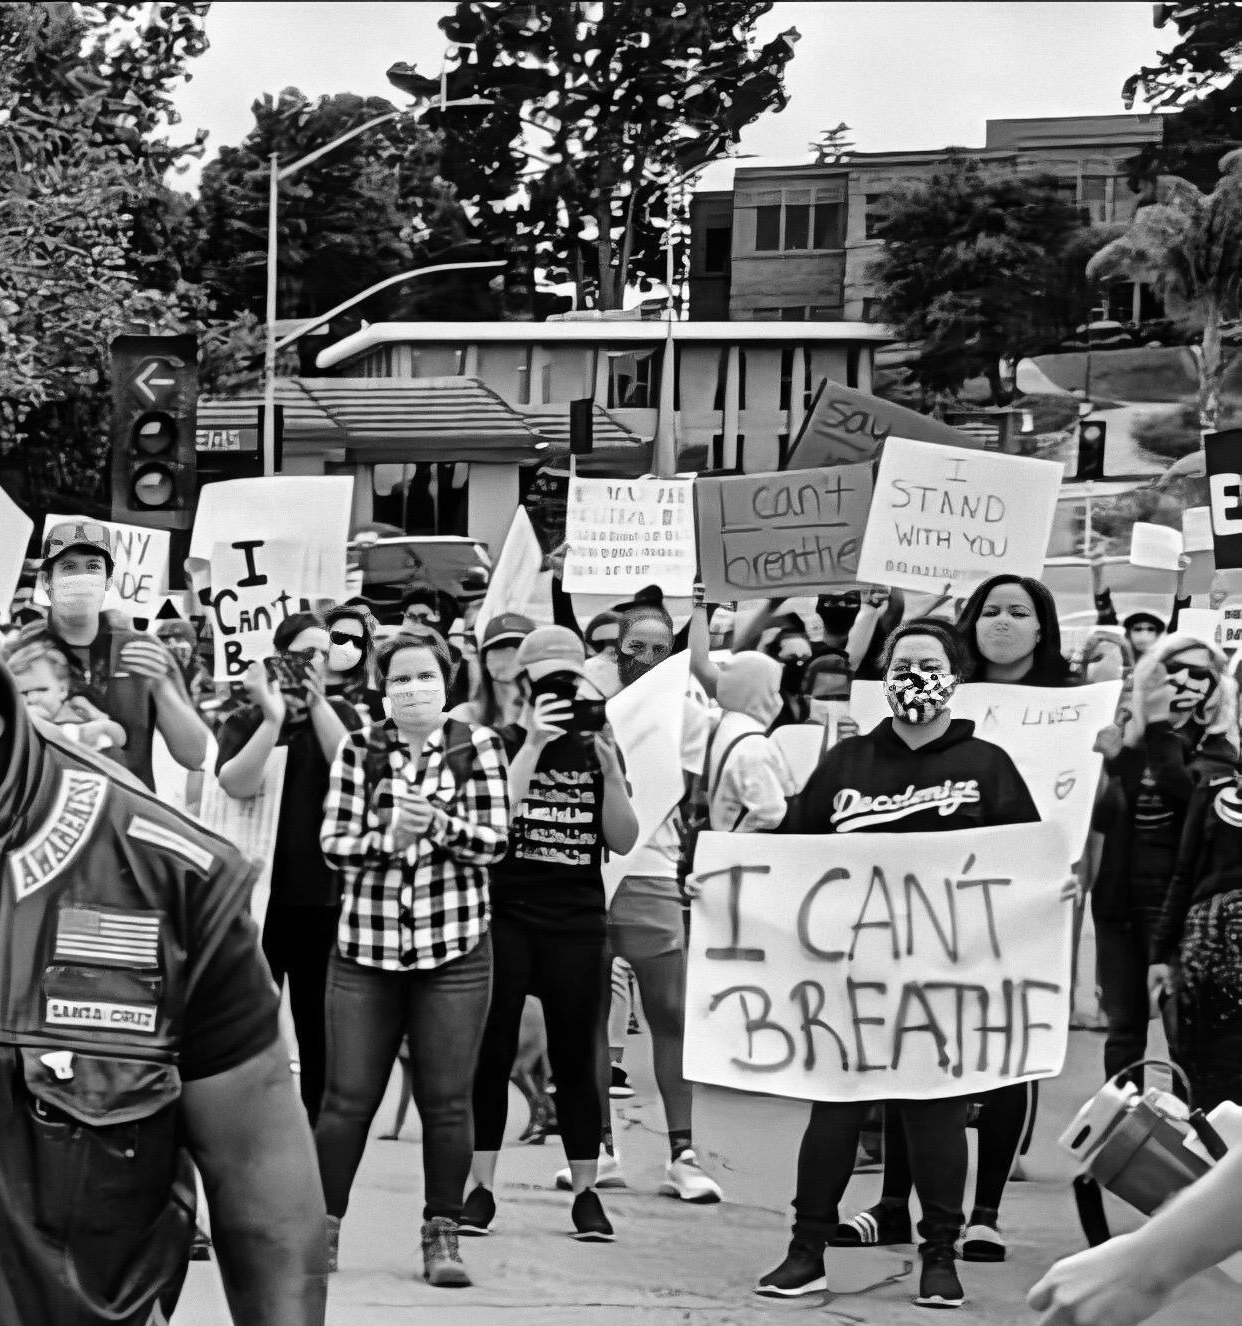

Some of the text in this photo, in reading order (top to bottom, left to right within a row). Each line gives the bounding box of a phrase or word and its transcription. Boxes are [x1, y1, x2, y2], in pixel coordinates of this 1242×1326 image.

[946, 458, 968, 483] I
[891, 479, 1006, 523] STAND
[895, 522, 1008, 558] WITH YOU
[231, 540, 268, 588] I
[695, 852, 1013, 964] I CAN'T
[708, 976, 1061, 1079] BREATHE
